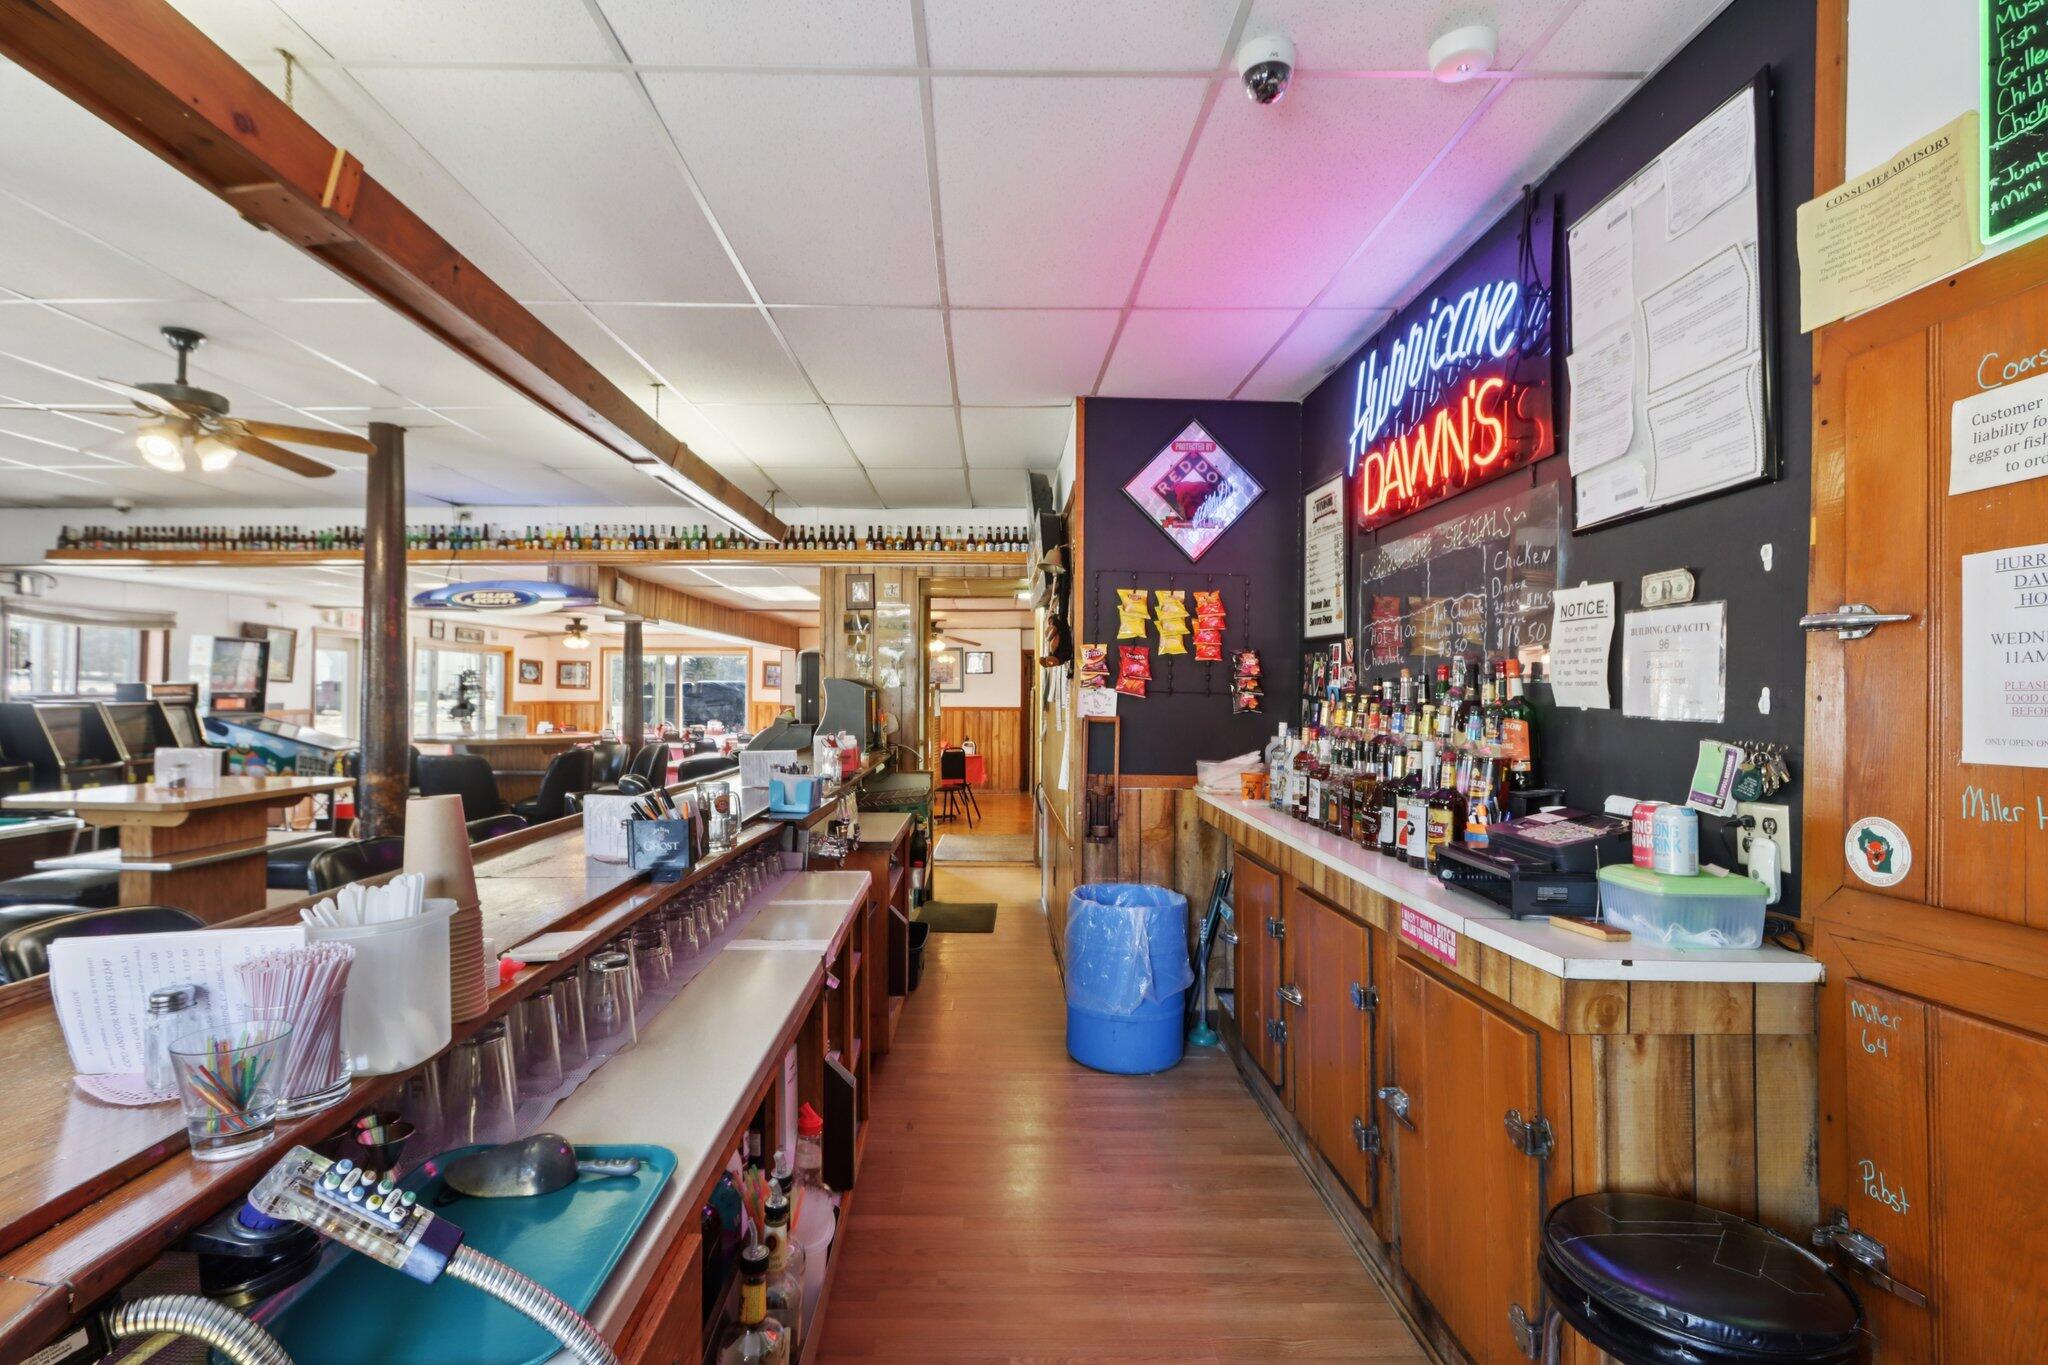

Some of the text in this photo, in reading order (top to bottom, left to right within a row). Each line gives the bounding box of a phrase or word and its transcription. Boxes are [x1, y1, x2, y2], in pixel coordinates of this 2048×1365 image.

[1996, 0, 2045, 33] Mus
[2000, 25, 2037, 57] Fish
[1826, 170, 1890, 208] CONSUMER
[1890, 135, 1951, 175] ADVISORY
[1349, 280, 1518, 476] Hurricane
[1972, 399, 2043, 426] Customer
[1974, 422, 2029, 445] liability
[1969, 447, 1999, 465] eggs
[2004, 442, 2020, 455] or
[2006, 460, 2020, 472] to
[1157, 461, 1192, 495] RED
[1443, 506, 1511, 549] SPECIALS
[1561, 600, 1608, 619] NOTICE:
[1630, 622, 1712, 637] BUILDING CAPACITY
[1991, 631, 2048, 646] WEDN
[2006, 694, 2039, 703] FOOD
[1985, 738, 2007, 747] ONLY
[2009, 738, 2034, 748] OPEN
[1962, 785, 2025, 822] Miller
[643, 842, 680, 851] GHOST
[1436, 923, 1456, 947] BITCH
[102, 959, 115, 993] SHRIMP
[107, 995, 118, 1016] MINI
[1852, 1000, 1902, 1030] Miller
[1862, 1029, 1888, 1058] 64
[1858, 1160, 1911, 1216] Pabst
